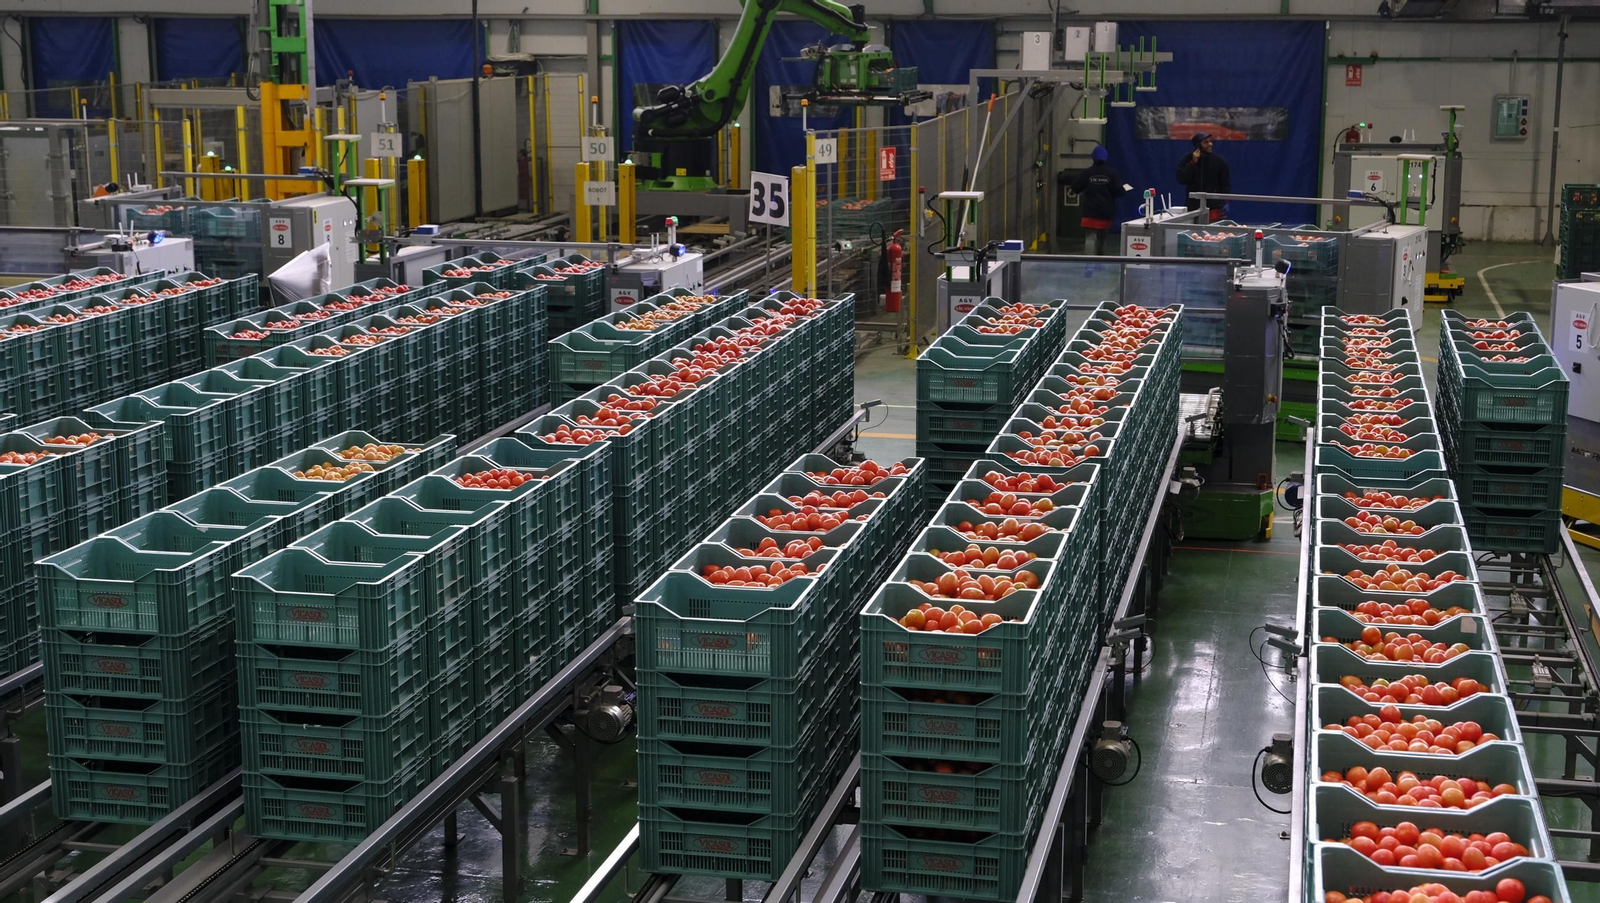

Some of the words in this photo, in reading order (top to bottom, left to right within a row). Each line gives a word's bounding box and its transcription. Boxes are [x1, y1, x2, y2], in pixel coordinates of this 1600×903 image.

[1034, 34, 1041, 44] 3
[1075, 30, 1081, 39] 2
[378, 138, 395, 151] 51
[590, 142, 607, 155] 50
[818, 143, 832, 157] 49
[1370, 182, 1377, 192] 6
[752, 180, 786, 219] 35
[277, 233, 285, 246] 8
[1576, 334, 1583, 349] 5
[292, 609, 323, 619] VICASOL
[925, 650, 960, 660] VICASOL
[697, 704, 734, 715] VICASOL
[924, 720, 959, 729] VICASOL
[297, 740, 330, 751] VICASOL
[698, 772, 733, 782] VICASOL
[923, 788, 959, 798] VICASOL
[699, 839, 734, 850] VICASOL
